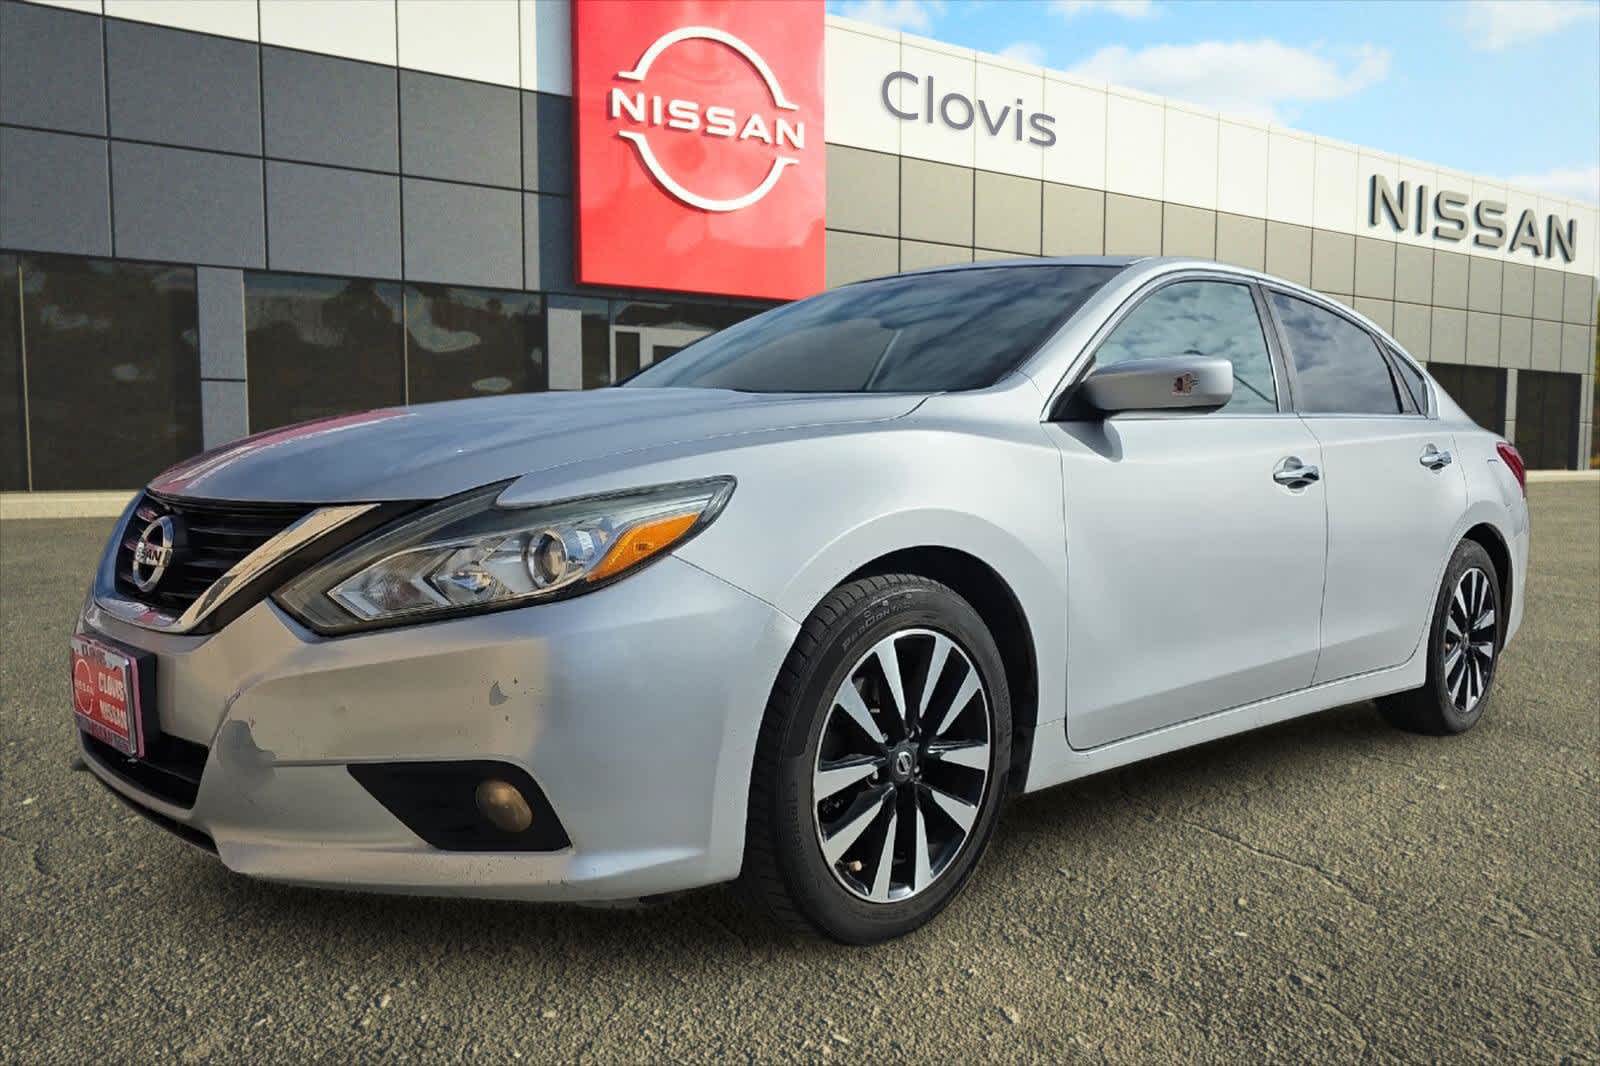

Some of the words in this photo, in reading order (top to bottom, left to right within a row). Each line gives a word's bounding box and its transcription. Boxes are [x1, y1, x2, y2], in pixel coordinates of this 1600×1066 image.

[611, 87, 805, 148] NISSAN
[881, 71, 1057, 147] Clovis
[1369, 174, 1577, 262] NISSAN
